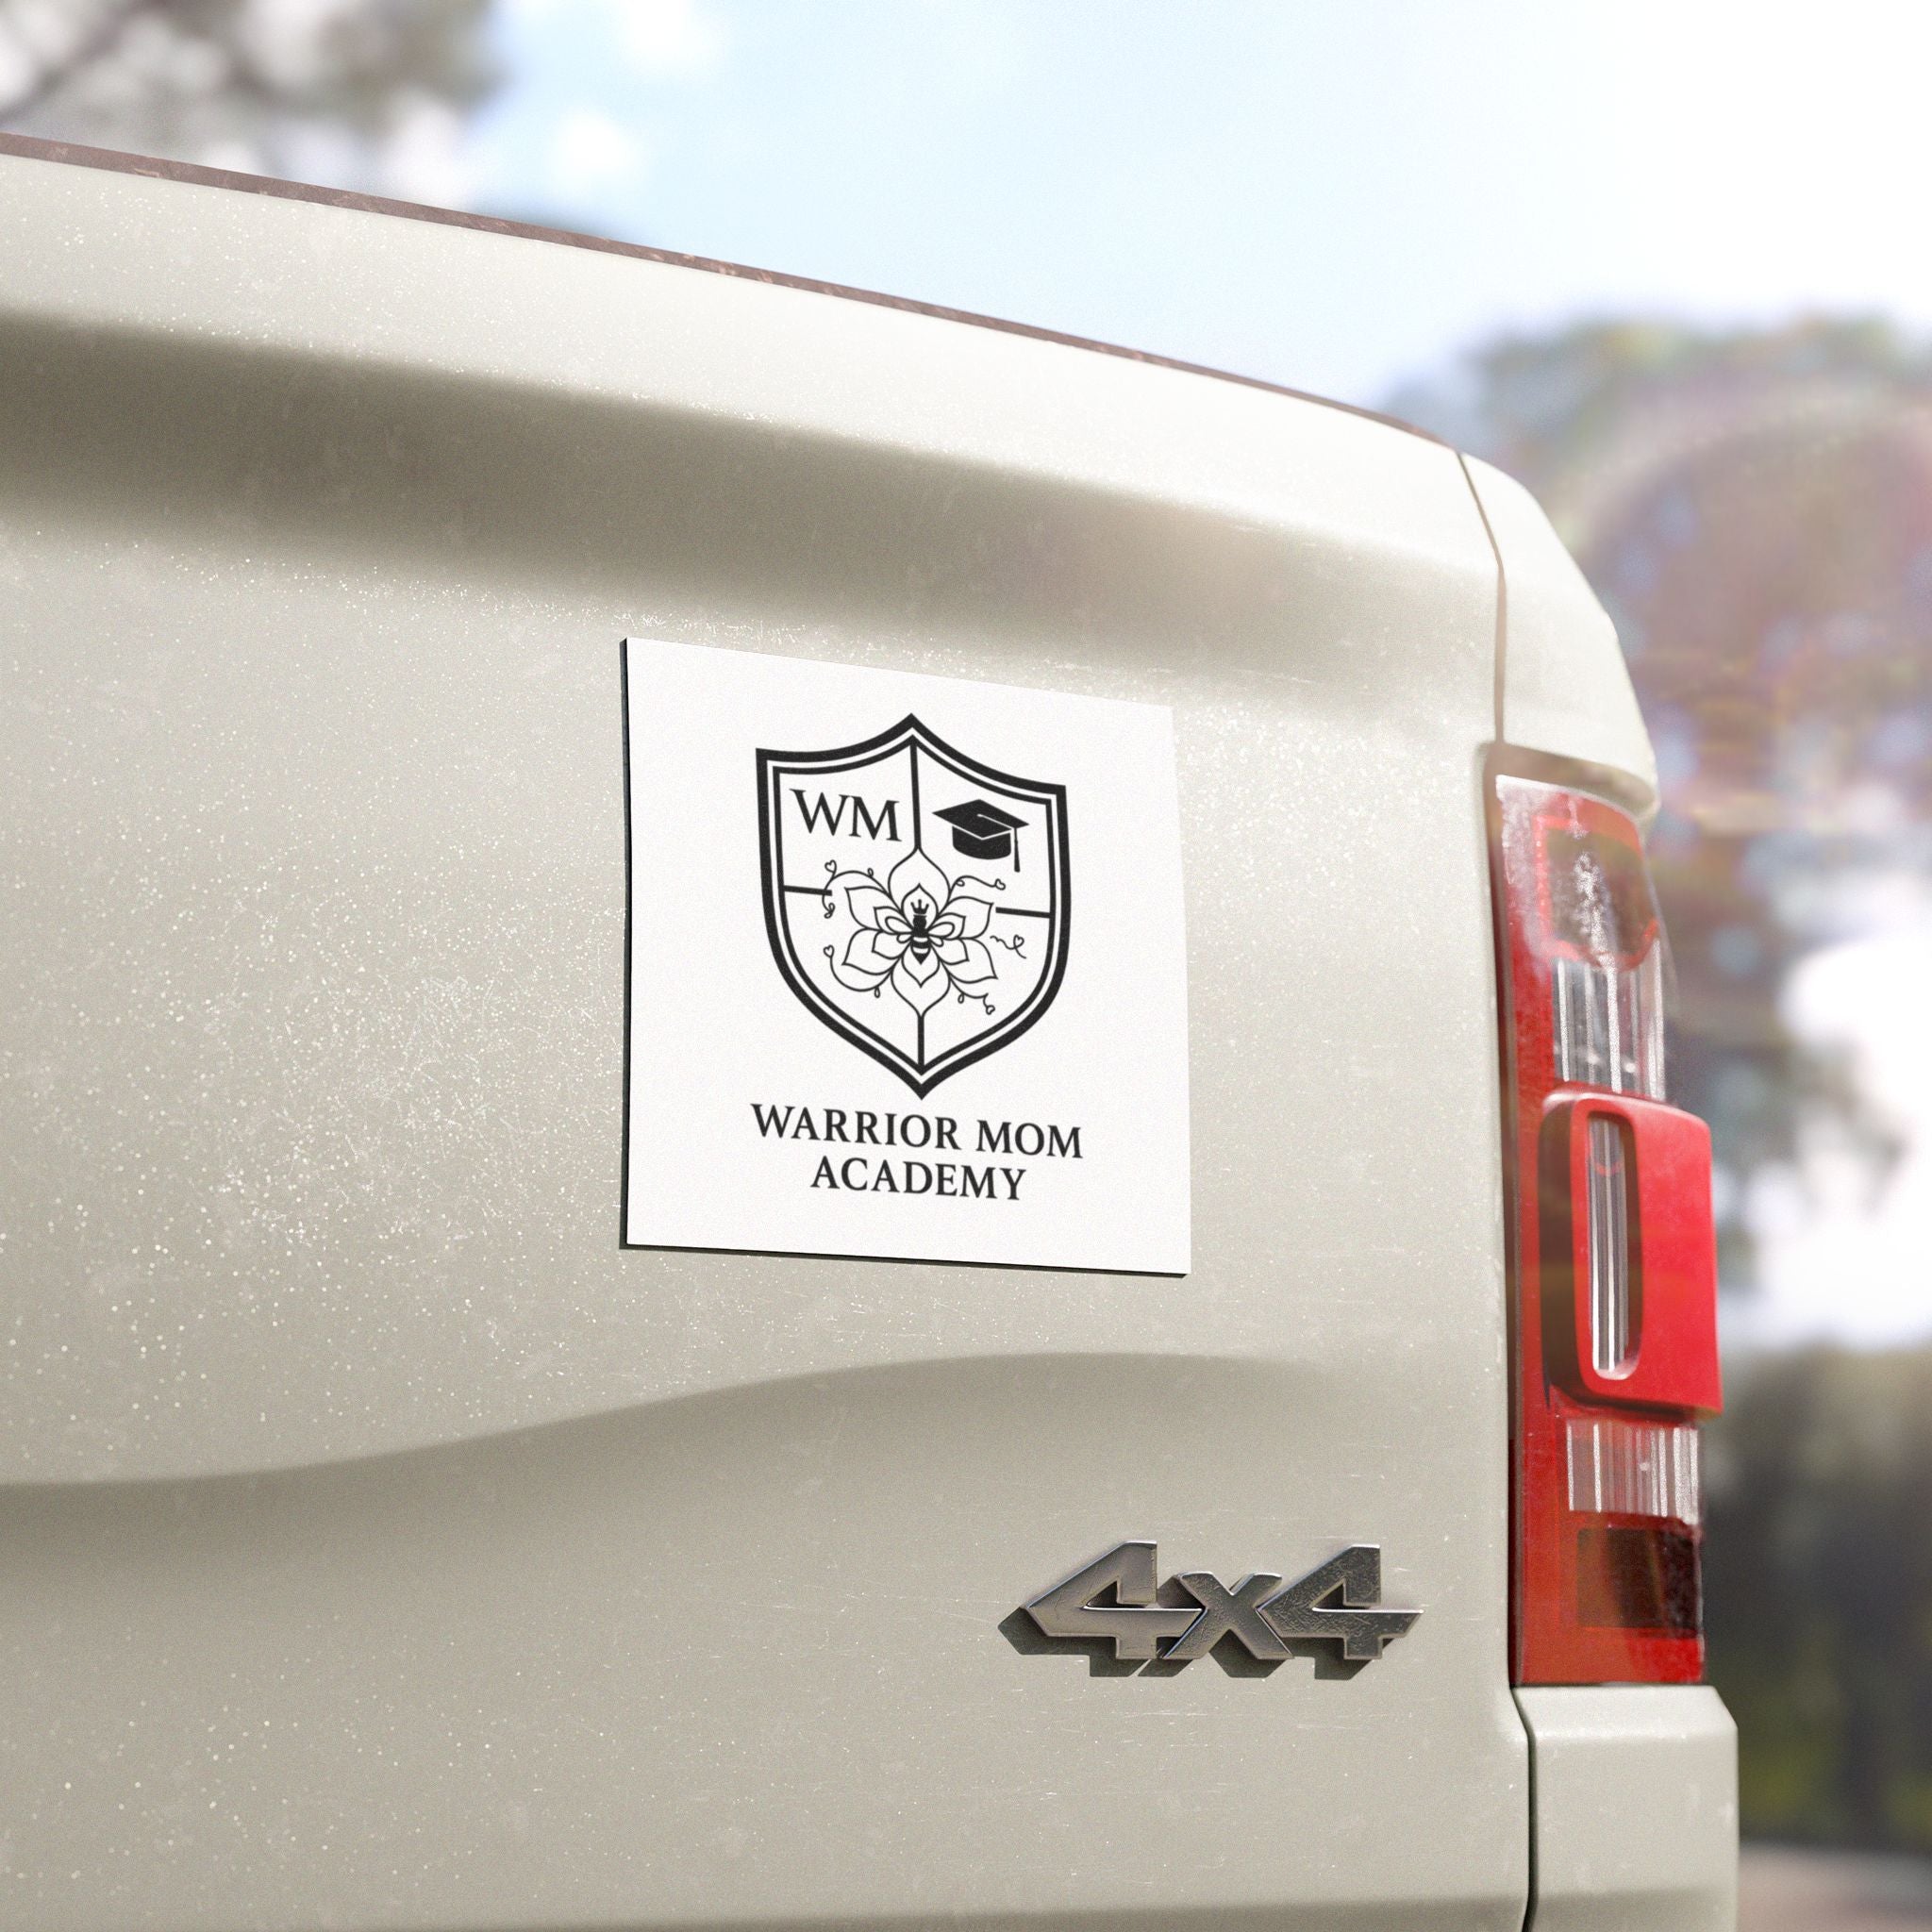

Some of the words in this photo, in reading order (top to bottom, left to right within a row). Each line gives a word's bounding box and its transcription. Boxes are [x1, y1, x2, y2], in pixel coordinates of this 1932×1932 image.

[790, 789, 902, 842] WM
[751, 1103, 961, 1150] WARRIOR
[975, 1120, 1084, 1158] MOM
[810, 1156, 1026, 1201] ACADEMY
